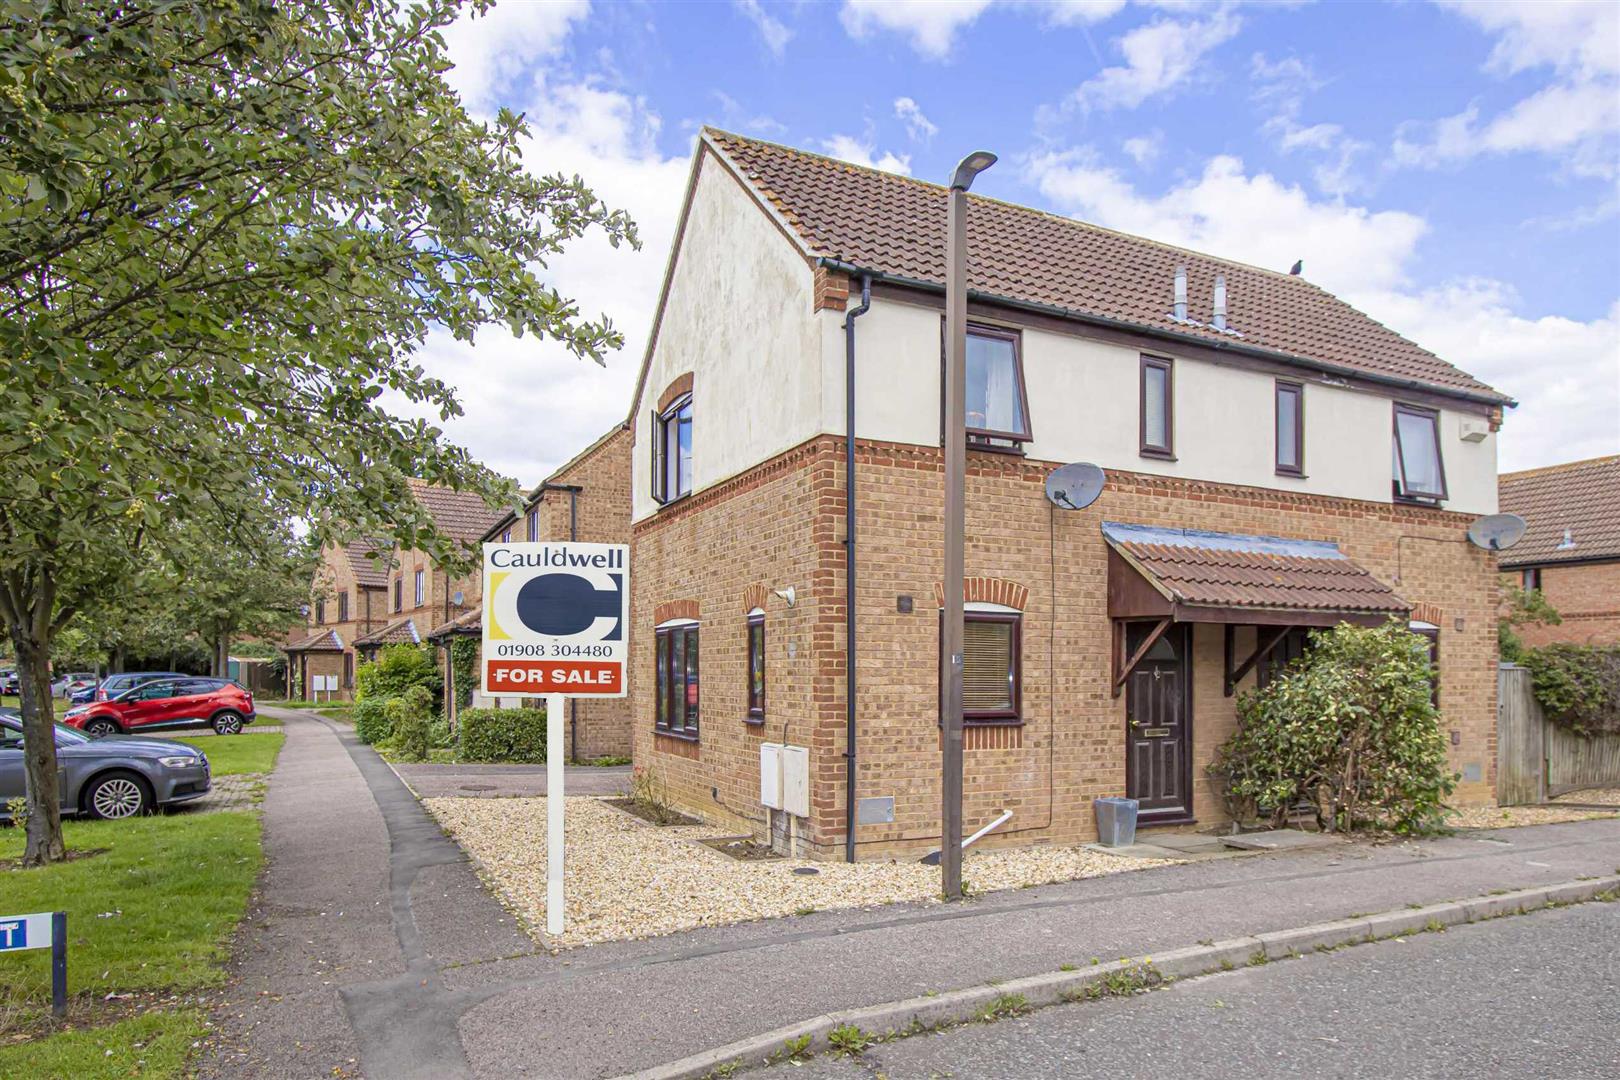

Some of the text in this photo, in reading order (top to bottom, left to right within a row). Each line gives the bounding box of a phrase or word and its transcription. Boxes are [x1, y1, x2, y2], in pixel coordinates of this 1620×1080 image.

[490, 547, 623, 568] Cauldwell
[493, 573, 619, 640] C
[498, 644, 613, 657] 01908 304480
[495, 669, 612, 684] FOR SALE
